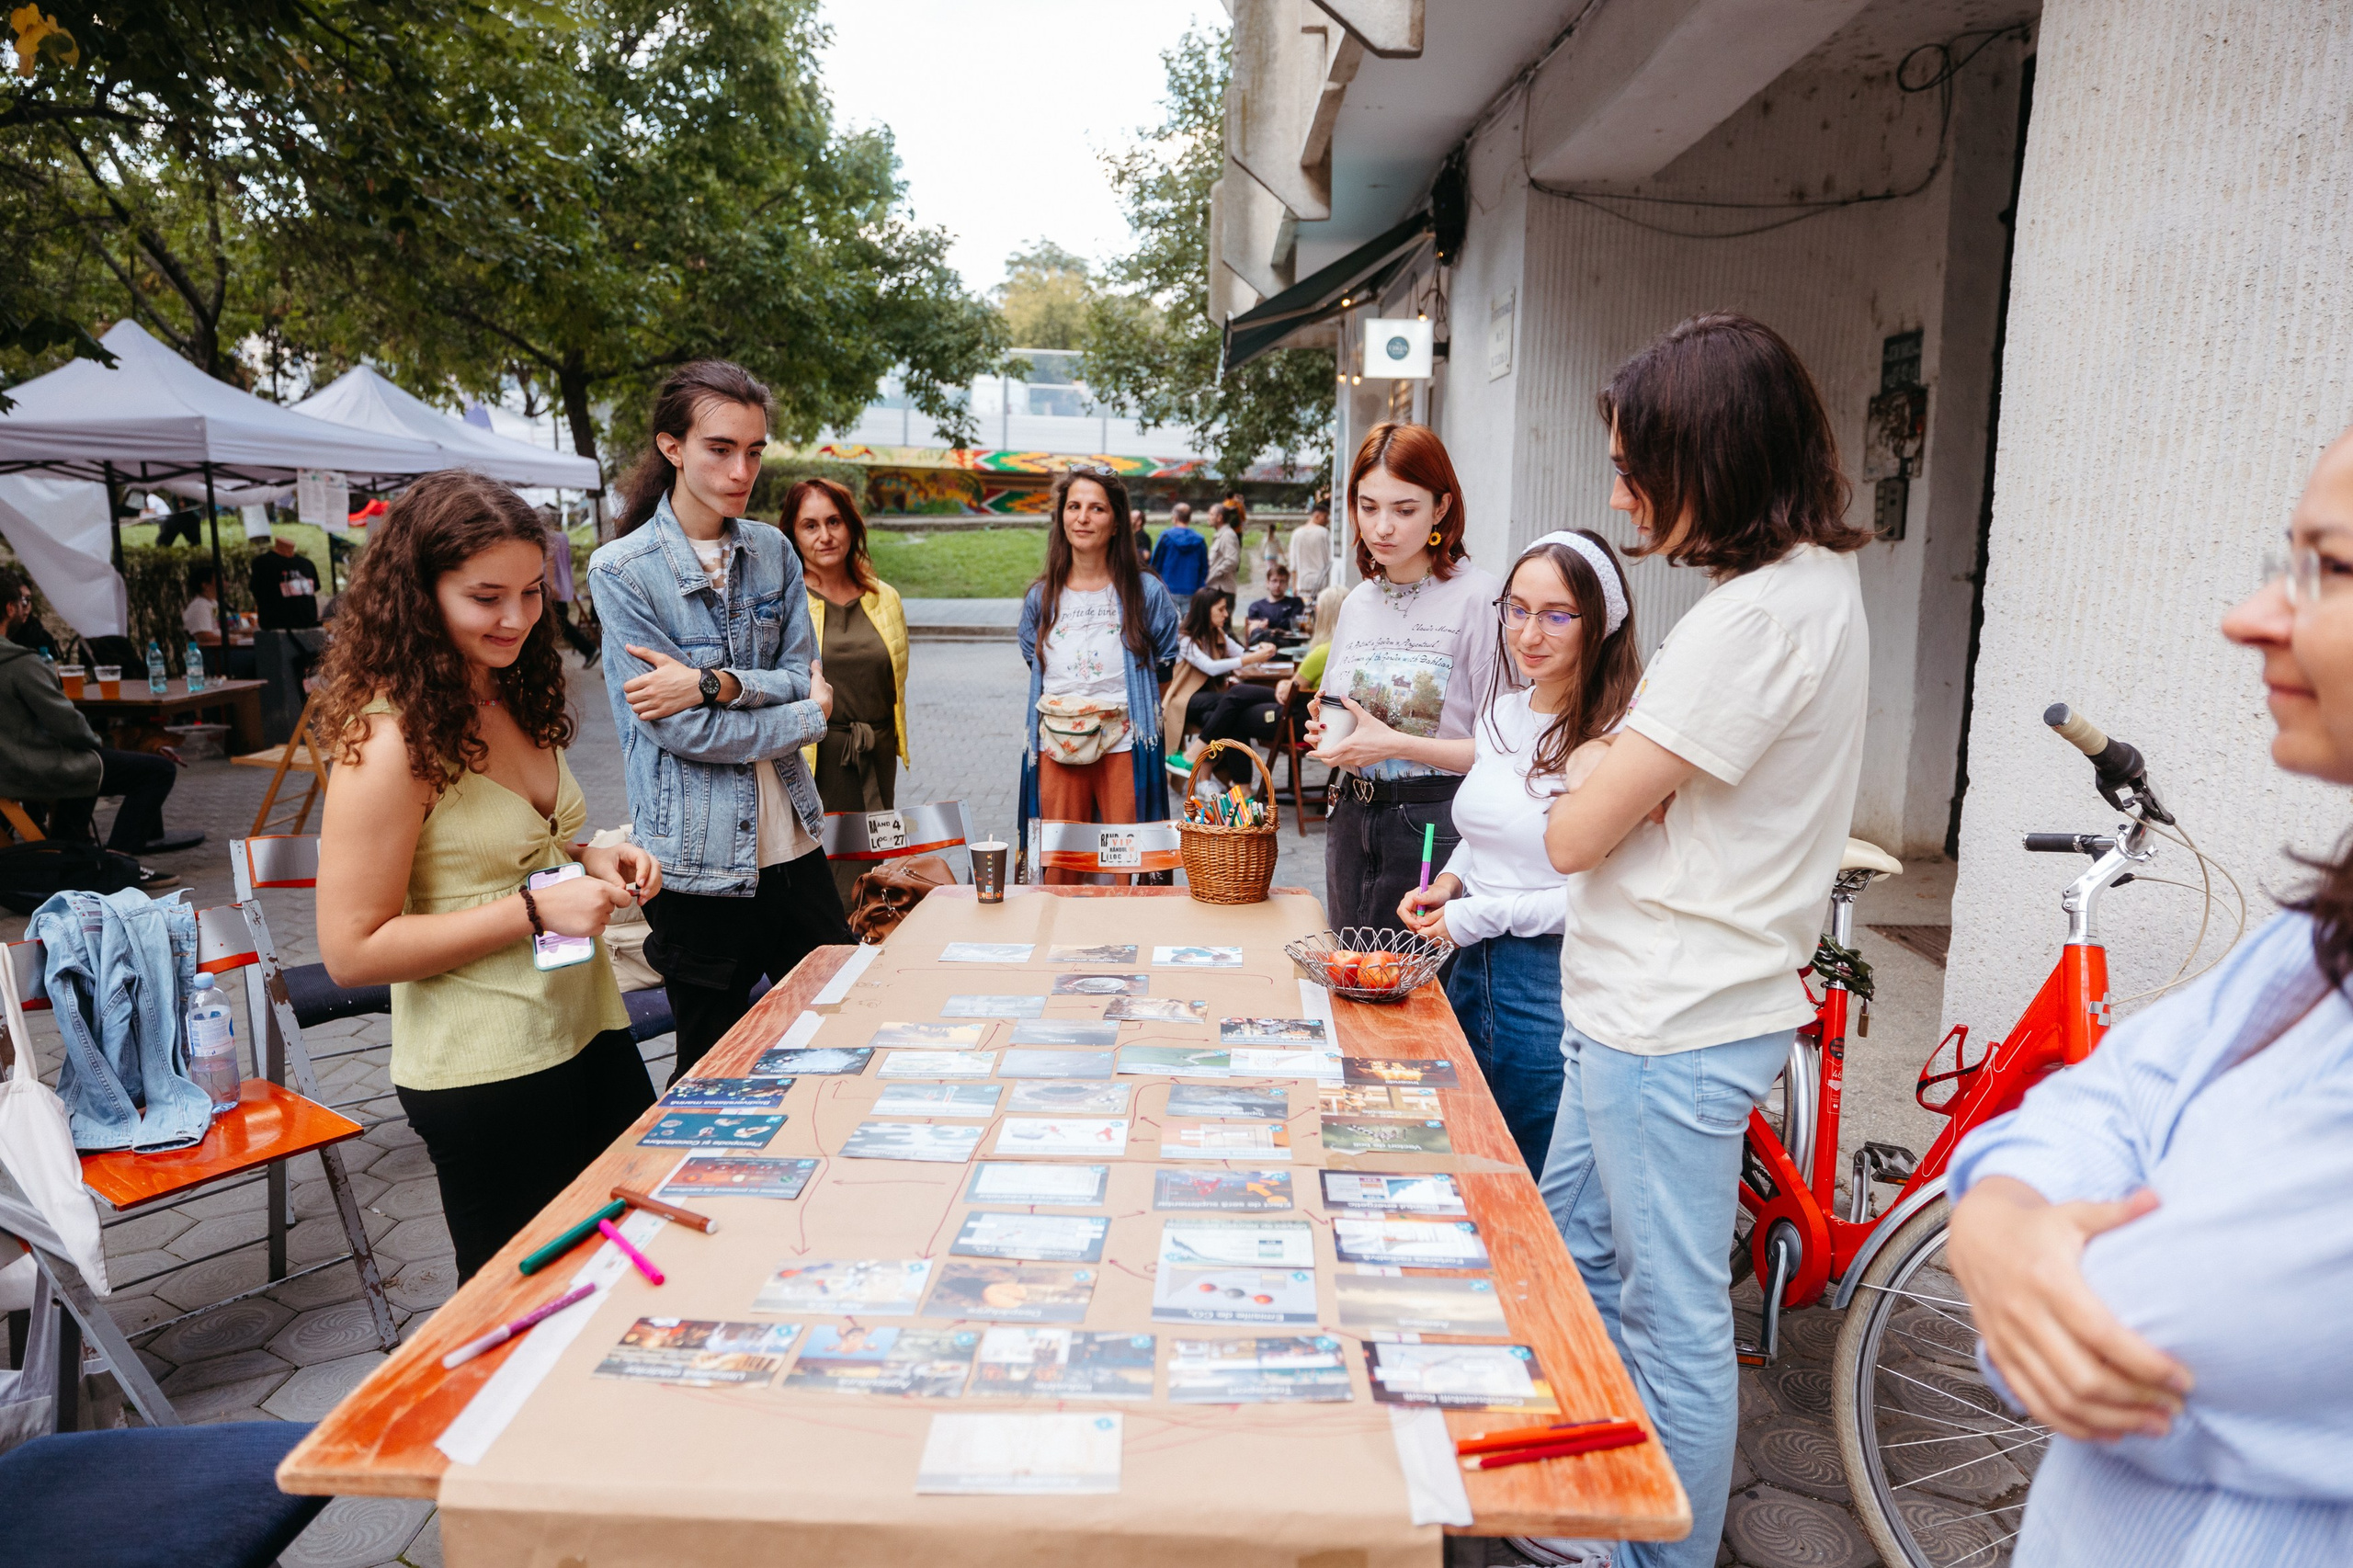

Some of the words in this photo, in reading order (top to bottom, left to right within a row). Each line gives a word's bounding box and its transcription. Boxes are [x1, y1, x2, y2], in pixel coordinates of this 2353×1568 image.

[893, 835, 905, 846] 27
[1112, 838, 1132, 846] VIP
[1831, 1069, 1842, 1079] 46
[1157, 1200, 1220, 1209] suplimentar
[1347, 1201, 1398, 1210] energetic
[1216, 1311, 1233, 1321] de
